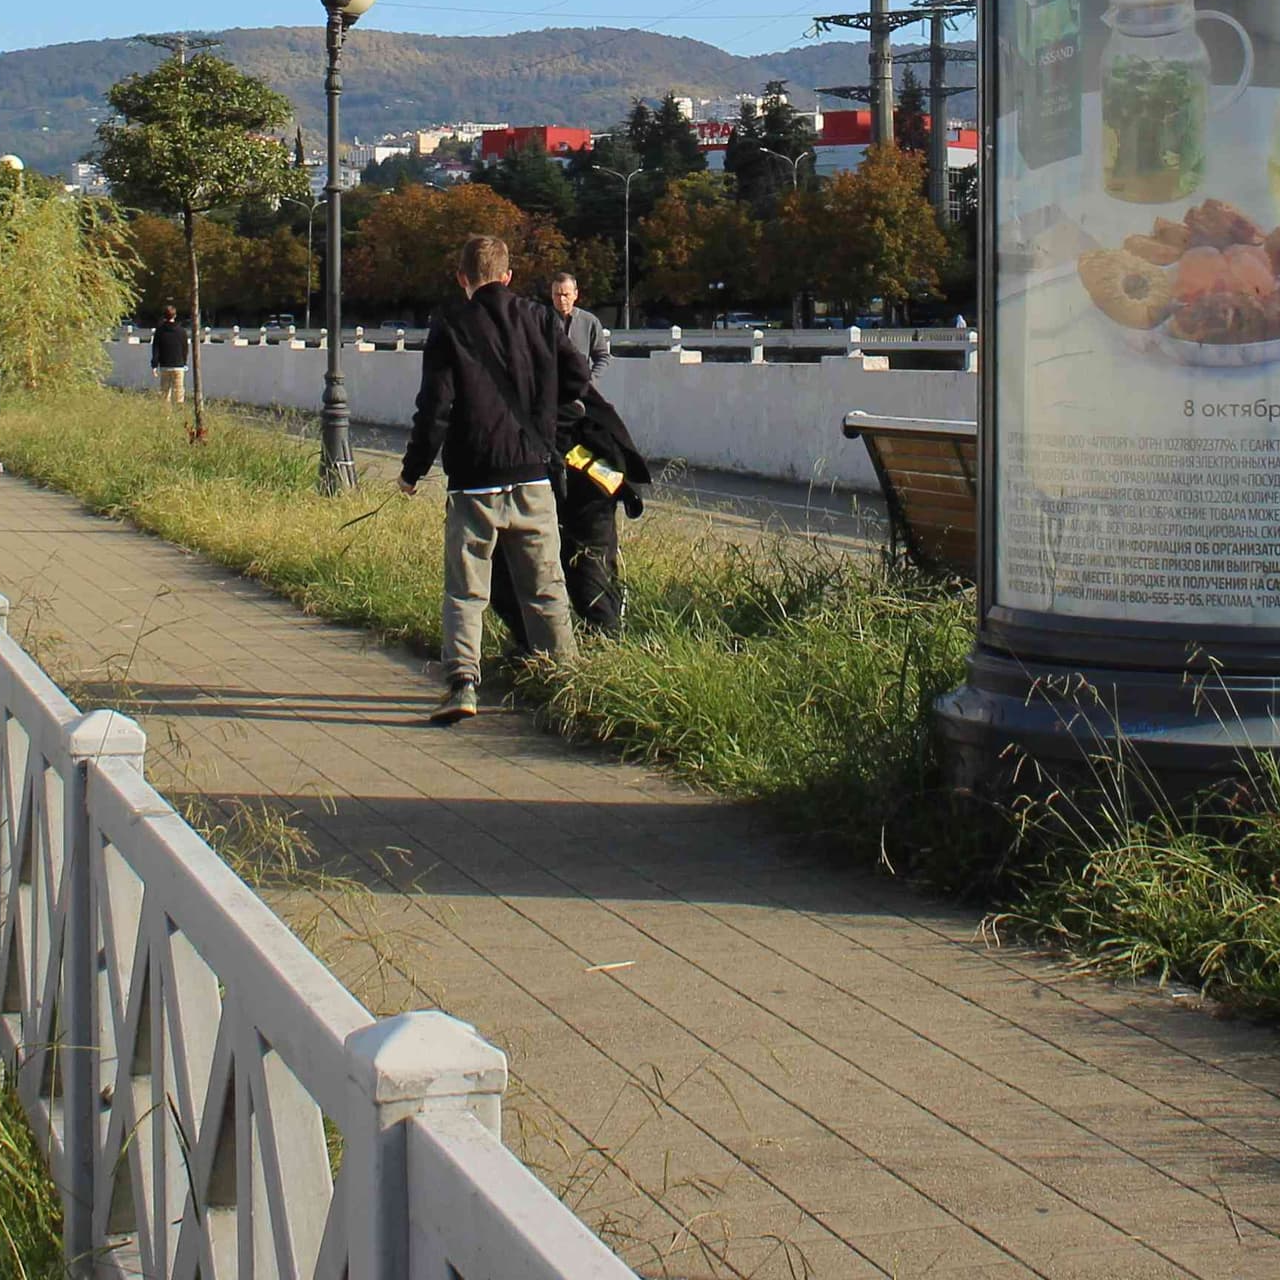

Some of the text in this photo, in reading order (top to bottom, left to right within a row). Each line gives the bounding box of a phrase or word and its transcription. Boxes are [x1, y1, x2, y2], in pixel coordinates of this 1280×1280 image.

[1184, 400, 1195, 417] 8
[1195, 455, 1266, 470] ЭЛЕКТРОННЫХ
[1206, 473, 1239, 488] АКЦИЯ
[1209, 507, 1246, 521] ТОВАРА
[1119, 539, 1191, 555] ИНФОРМАЦИЯ
[1195, 542, 1209, 555] ОБ
[1161, 557, 1201, 570] ПРИЗОВ
[1203, 559, 1224, 572] ИЛИ
[1082, 571, 1111, 585] МЕСТЕ
[1168, 575, 1182, 588] ИХ
[1183, 576, 1248, 590] ПОЛУЧЕНИЯ
[1250, 578, 1264, 591] НА
[1085, 587, 1118, 601] ЛИНИИ
[1120, 591, 1204, 605] 8-800-555-55-05.
[1206, 593, 1255, 607] РЕКЛАМА.
